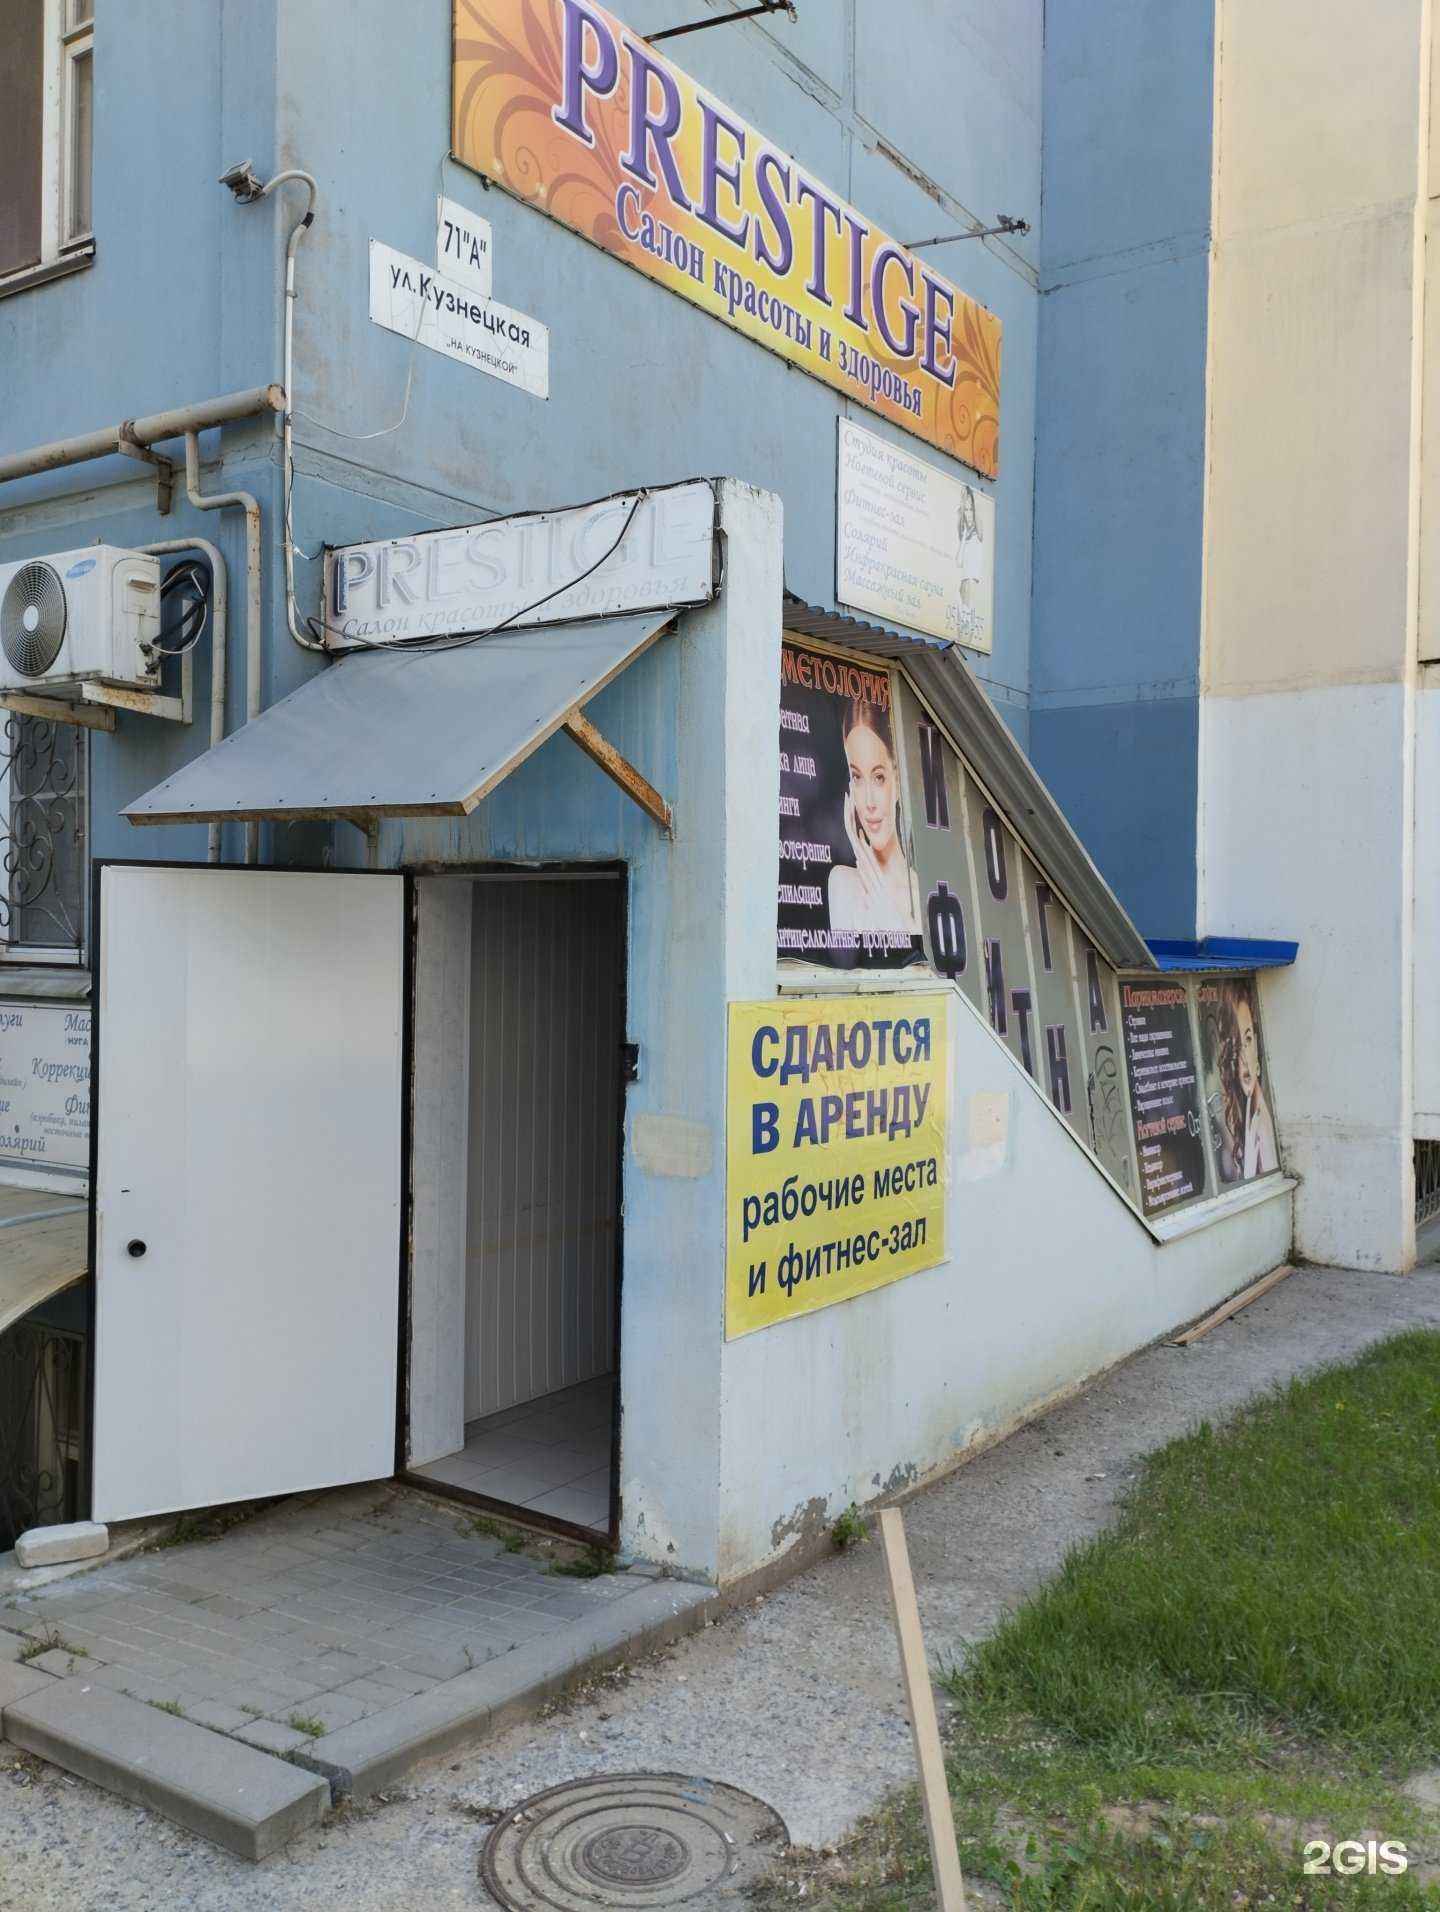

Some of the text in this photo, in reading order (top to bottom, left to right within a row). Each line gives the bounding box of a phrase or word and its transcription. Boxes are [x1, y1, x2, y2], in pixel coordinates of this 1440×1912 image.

[552, 0, 958, 388] PRESTIGE
[615, 183, 924, 418] Салон красоты и здоровья
[333, 490, 702, 616] PRESTIGE
[751, 1017, 931, 1086] СДАЮТСЯ
[752, 1082, 932, 1155] В АРЕНДУ
[743, 1157, 938, 1242] рабочие места
[748, 1217, 927, 1298] и фитнес-зал
